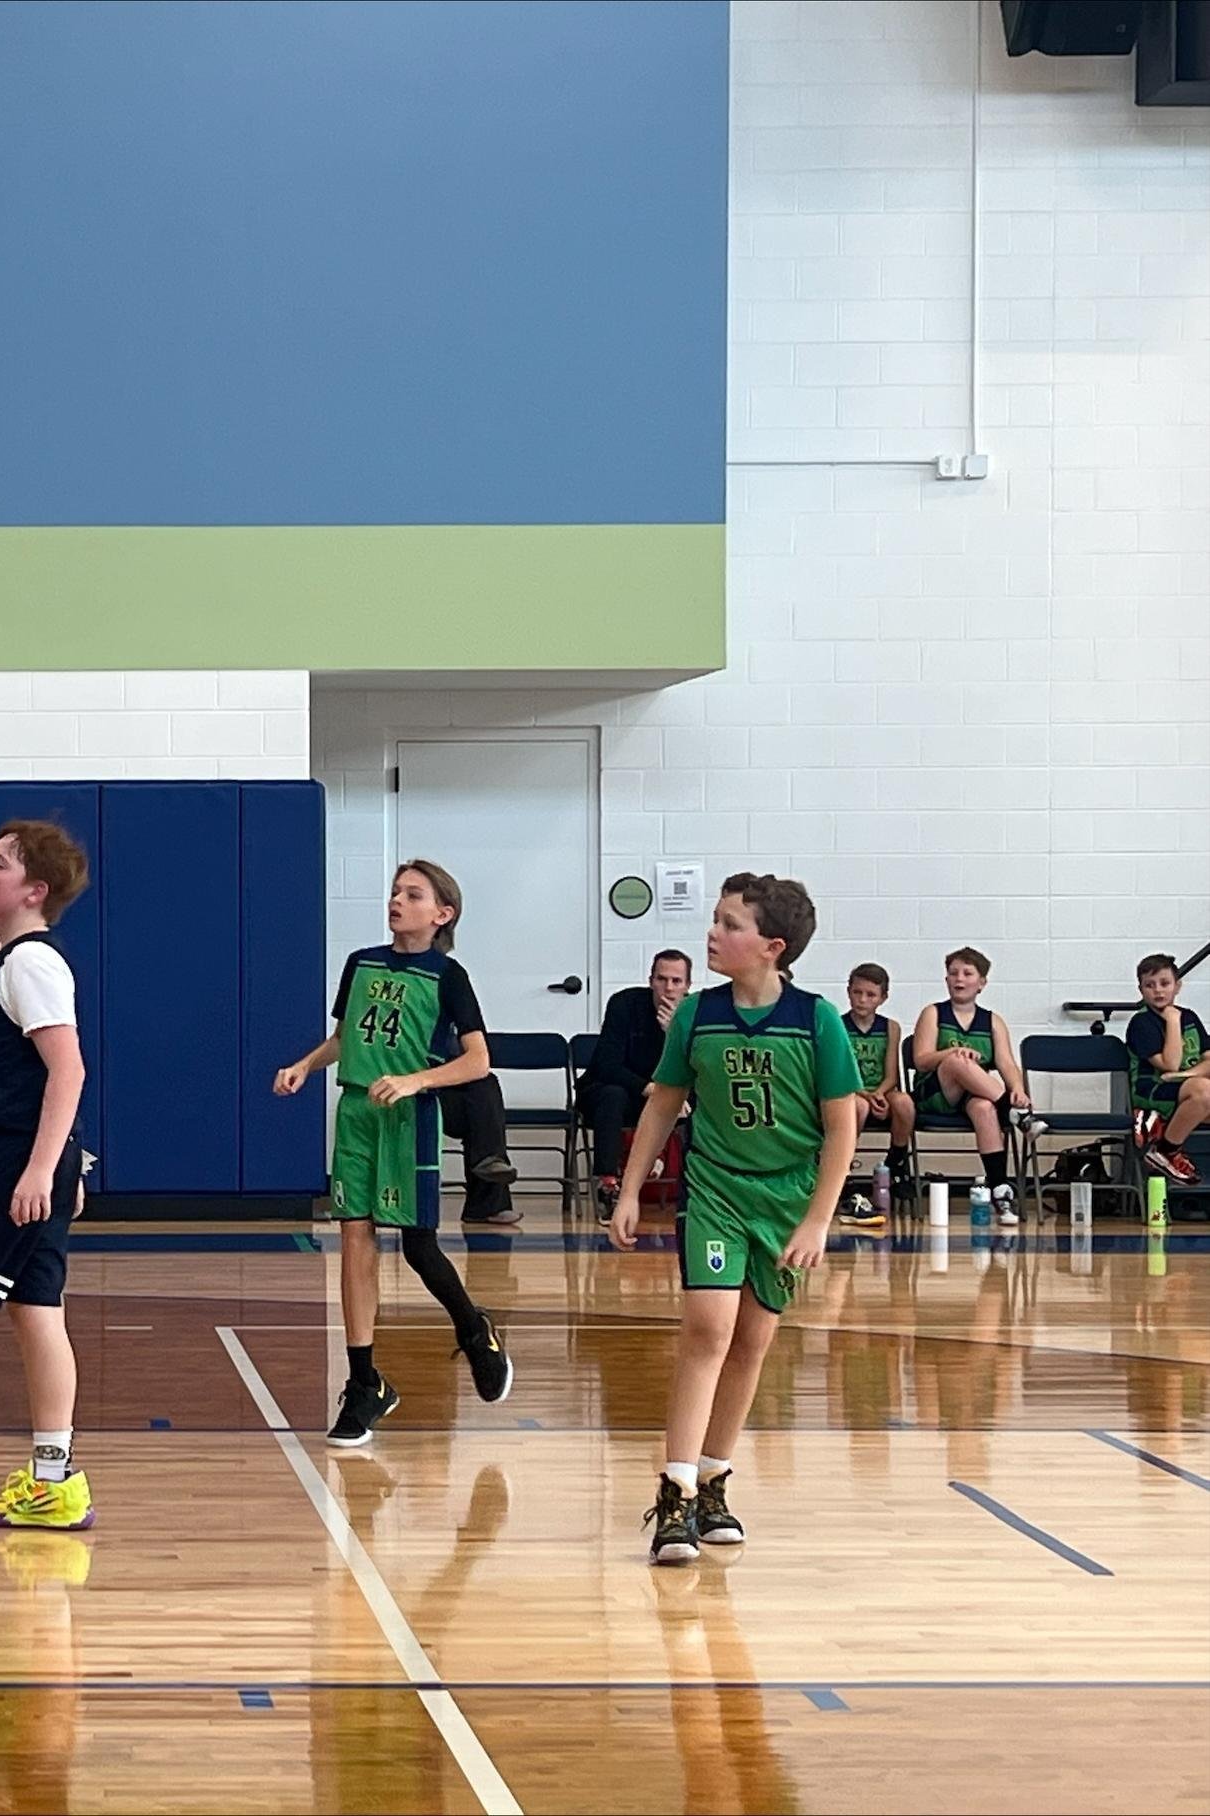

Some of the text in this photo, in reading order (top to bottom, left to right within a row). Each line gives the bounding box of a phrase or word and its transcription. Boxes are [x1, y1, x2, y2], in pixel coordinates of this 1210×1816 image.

[368, 979, 407, 1003] SMA
[359, 1004, 402, 1050] 44
[723, 1046, 776, 1076] SMA
[729, 1079, 778, 1130] 51
